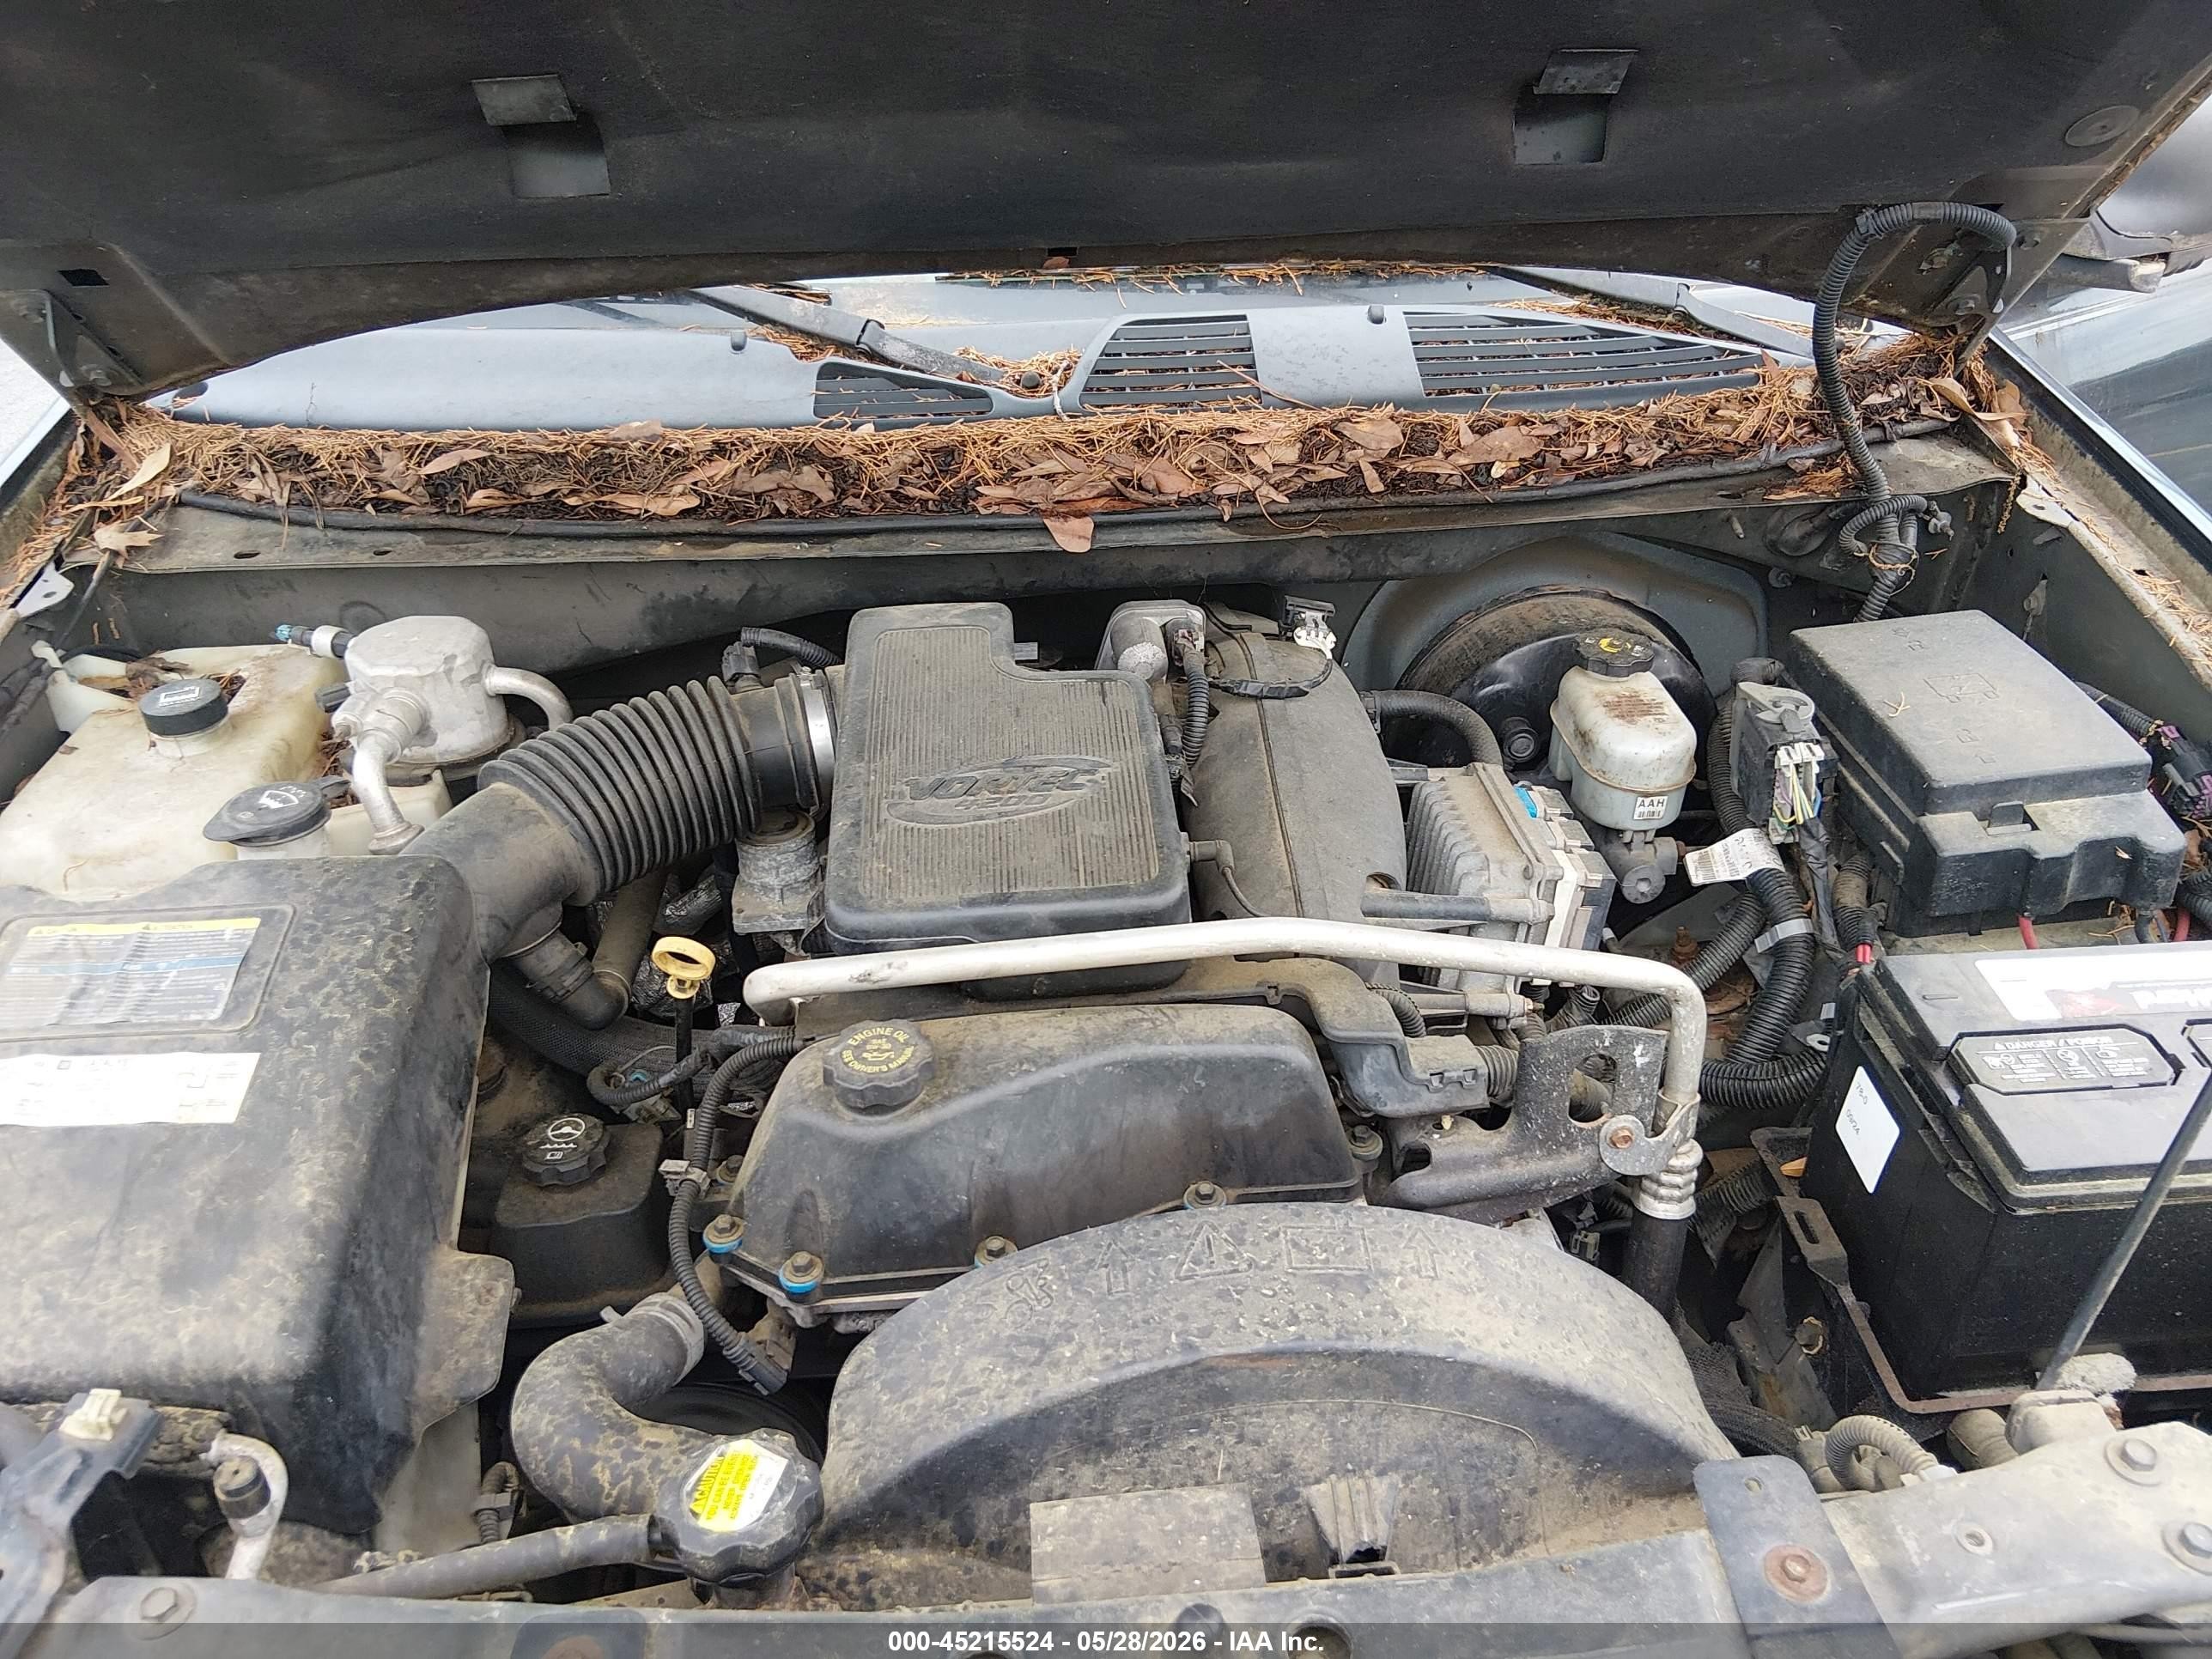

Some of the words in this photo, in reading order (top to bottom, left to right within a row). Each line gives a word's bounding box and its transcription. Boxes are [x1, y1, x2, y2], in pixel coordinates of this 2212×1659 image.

[904, 768, 1099, 801] VORTEC
[955, 793, 1051, 810] 4200
[1638, 799, 1665, 808] AAH
[847, 1027, 894, 1046] ENGINE
[892, 1030, 910, 1043] OIL
[2005, 1039, 2057, 1049] DANGER
[842, 1049, 854, 1063] SEE
[888, 1046, 915, 1069] MANUAL
[694, 1456, 725, 1501] CAUTION
[705, 1504, 718, 1520] YOU
[713, 1487, 725, 1502] CAN
[720, 1476, 729, 1486] BE
